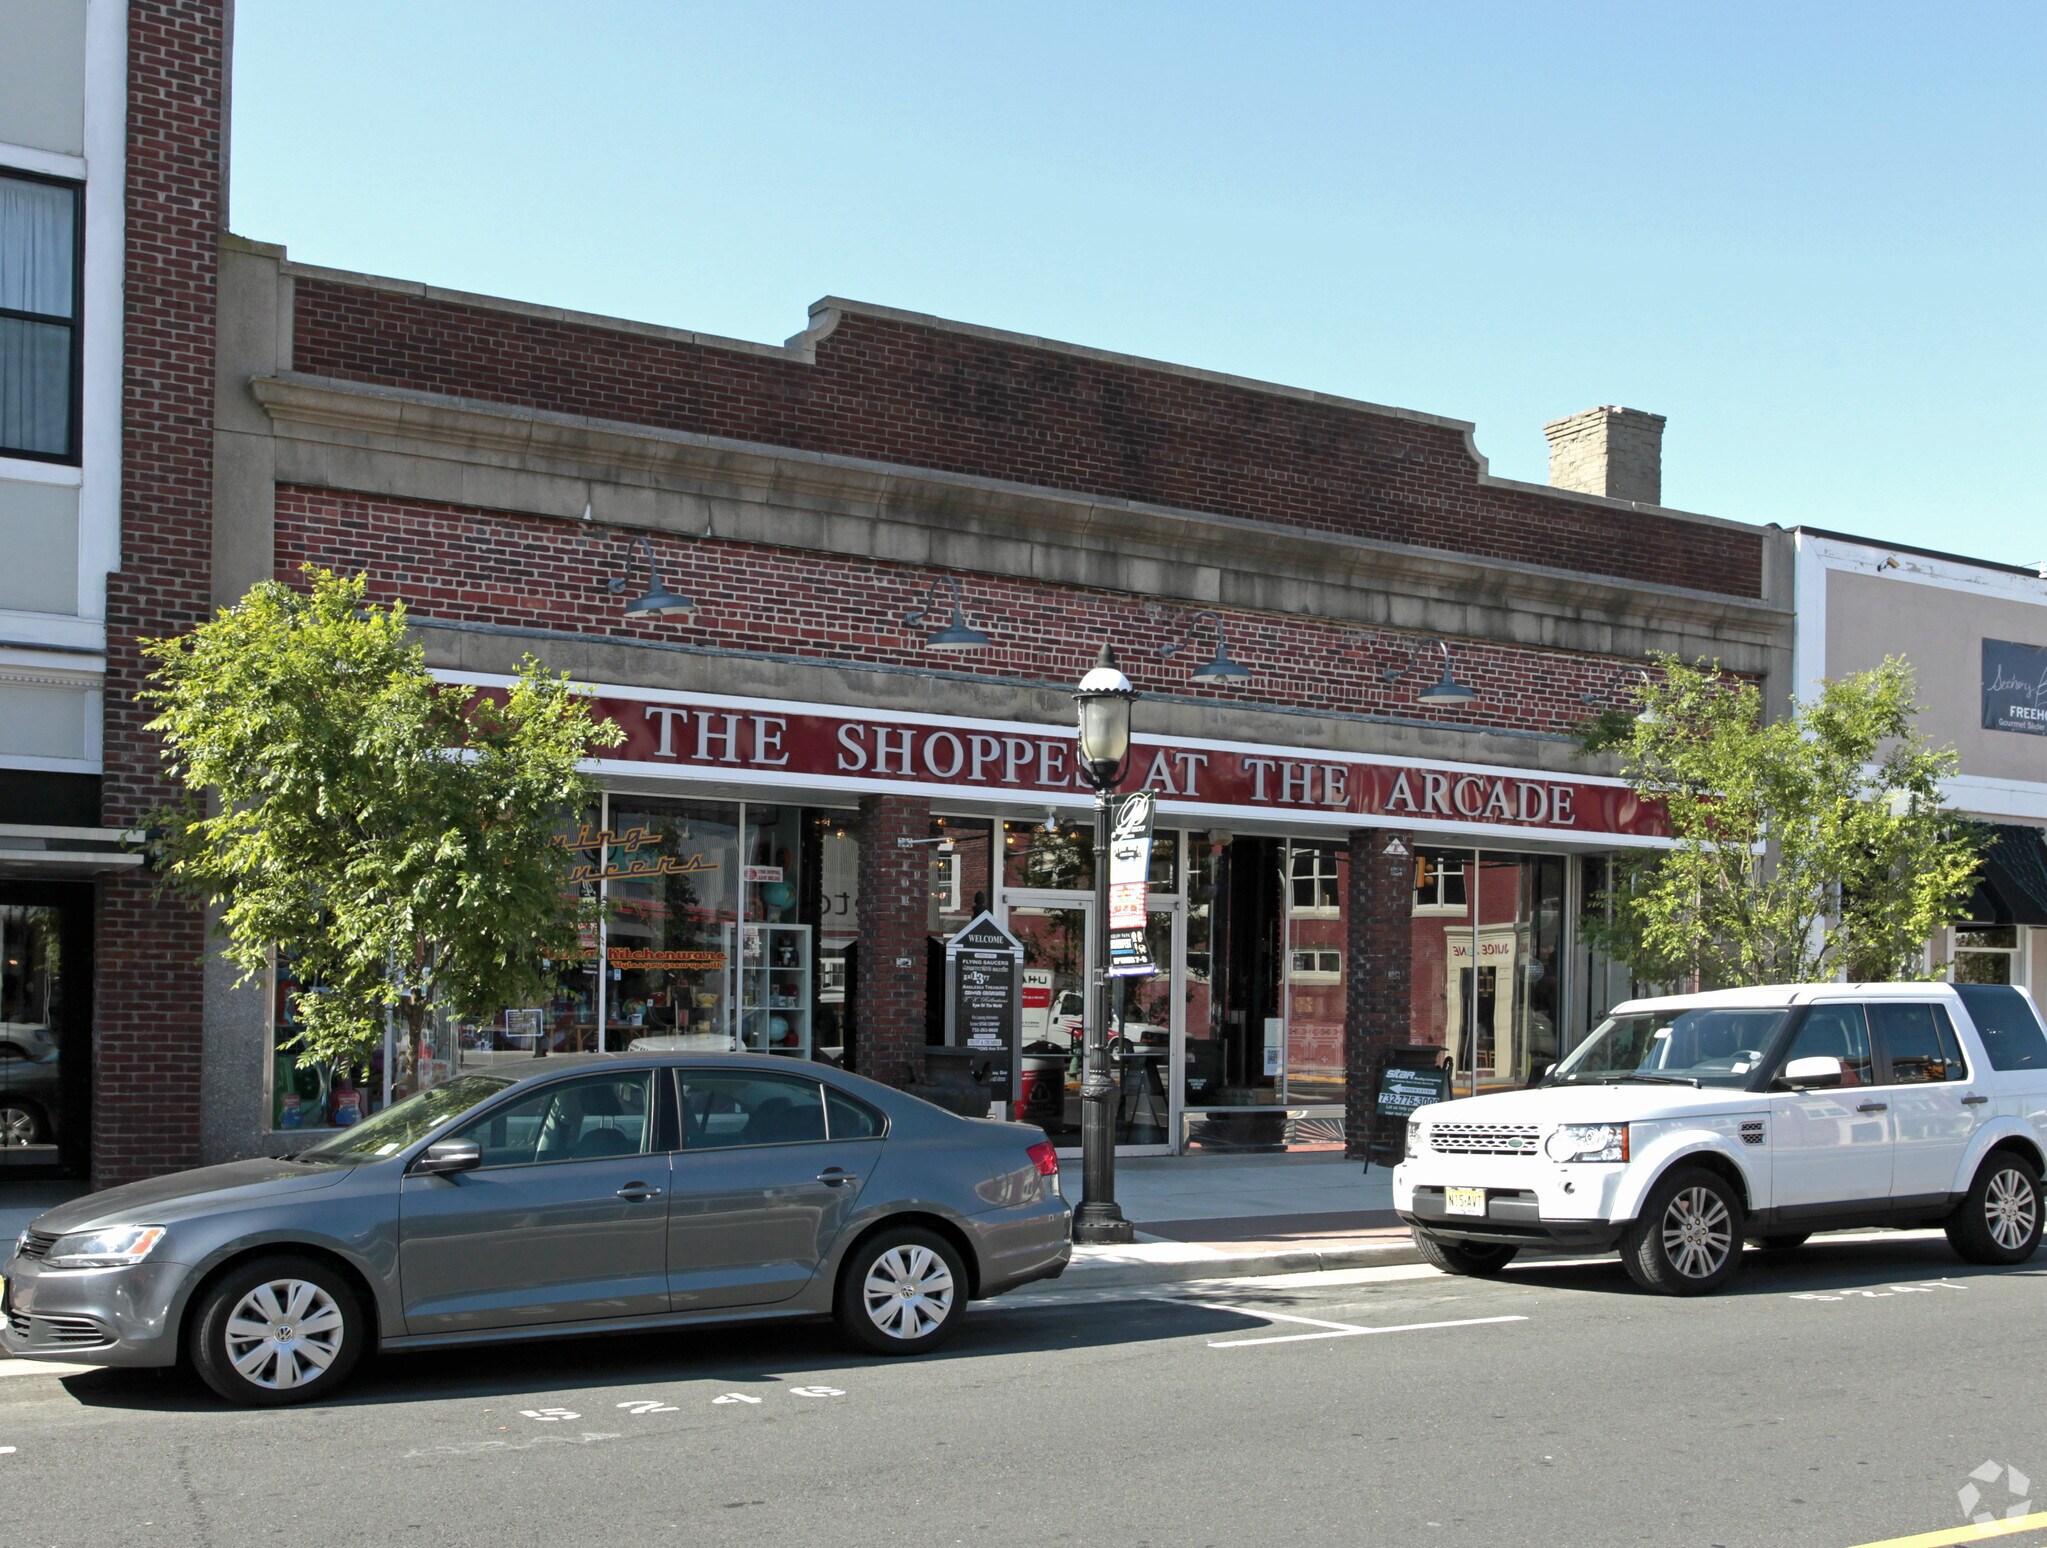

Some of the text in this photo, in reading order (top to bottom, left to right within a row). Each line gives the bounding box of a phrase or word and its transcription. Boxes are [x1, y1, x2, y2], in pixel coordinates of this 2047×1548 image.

[2010, 705, 2047, 722] FREEH
[1998, 718, 2045, 731] Gourmet Slider
[645, 706, 789, 766] THE
[1141, 750, 1208, 797] AT
[1244, 757, 1350, 807] THE
[1384, 771, 1576, 826] ARCADE
[968, 934, 1004, 944] WELCOME
[607, 947, 728, 961] Kitchenware
